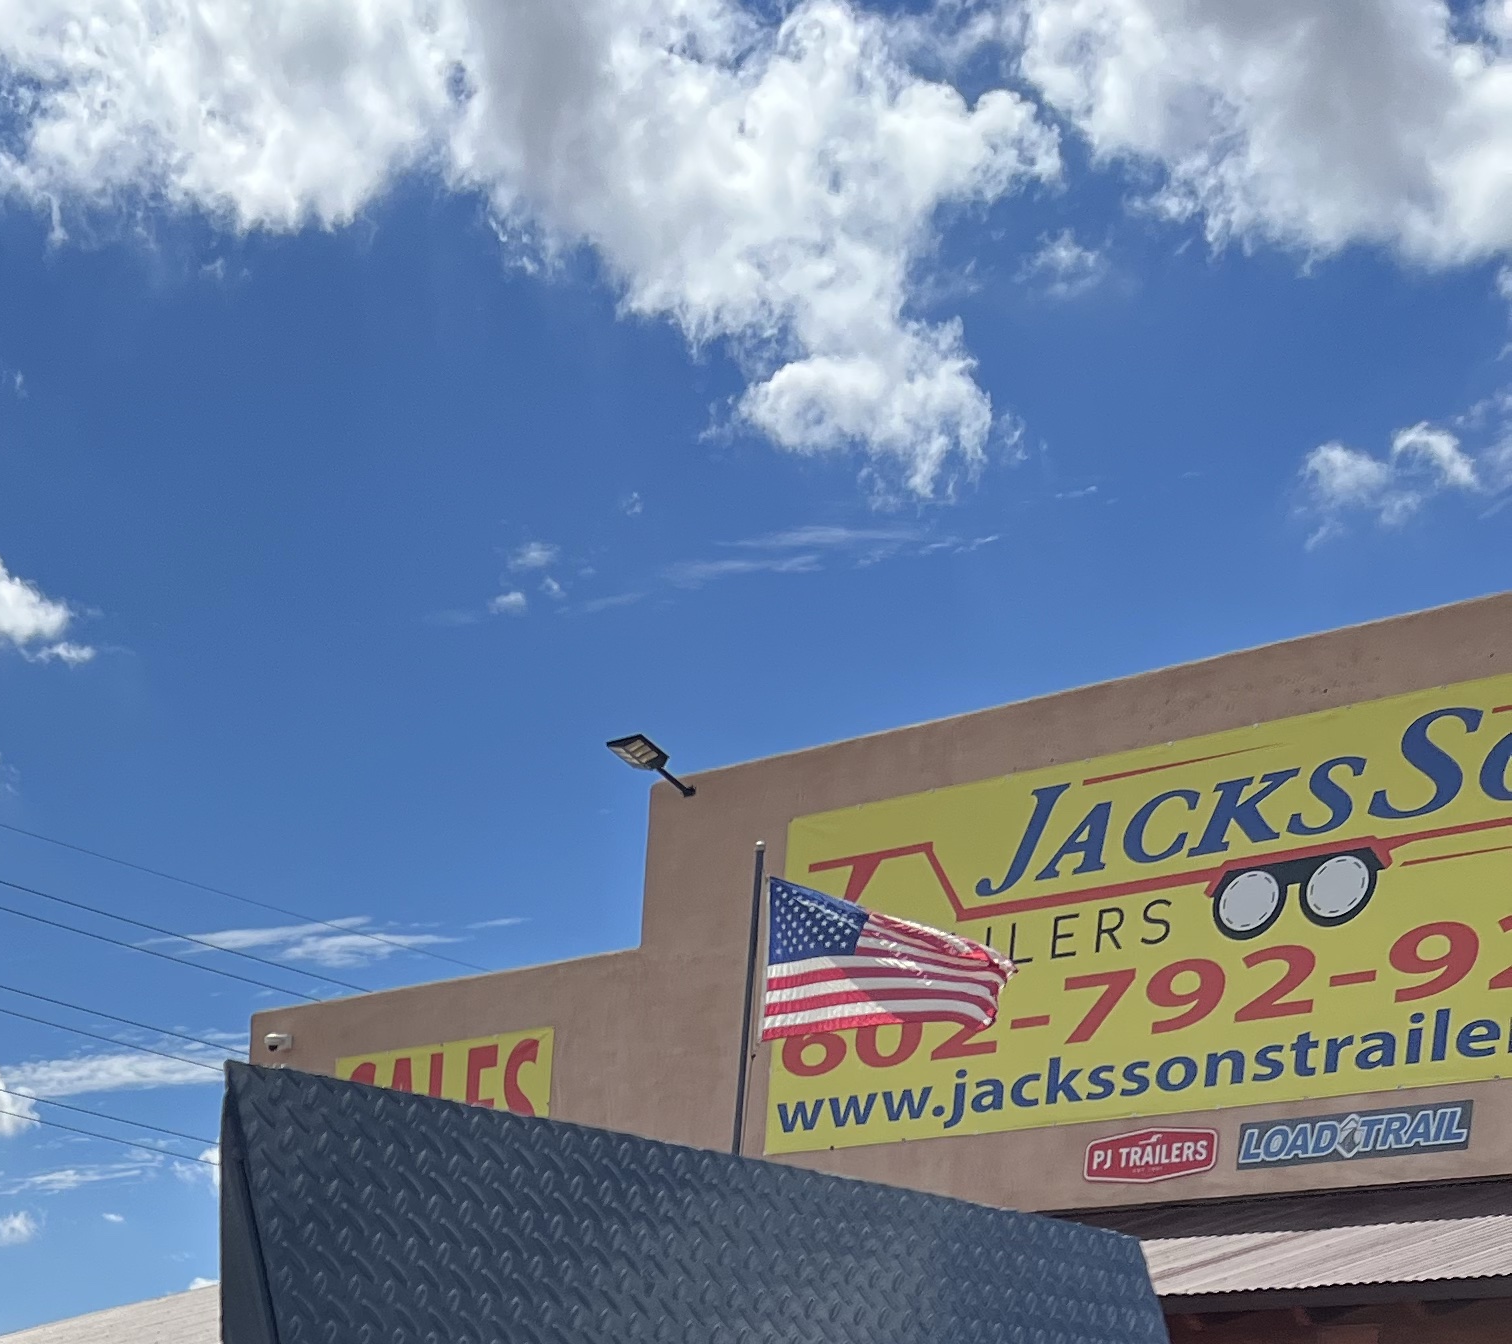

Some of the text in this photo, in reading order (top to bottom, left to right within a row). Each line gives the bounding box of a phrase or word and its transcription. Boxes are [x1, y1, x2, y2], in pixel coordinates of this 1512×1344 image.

[985, 898, 1172, 965] ILERS
[781, 914, 1512, 1078] 602-792-9
[776, 1007, 1512, 1133] www.jackssonstraile
[1091, 1139, 1209, 1171] PJ TRAILERS
[1238, 1106, 1468, 1164] LOAD TRAIL
